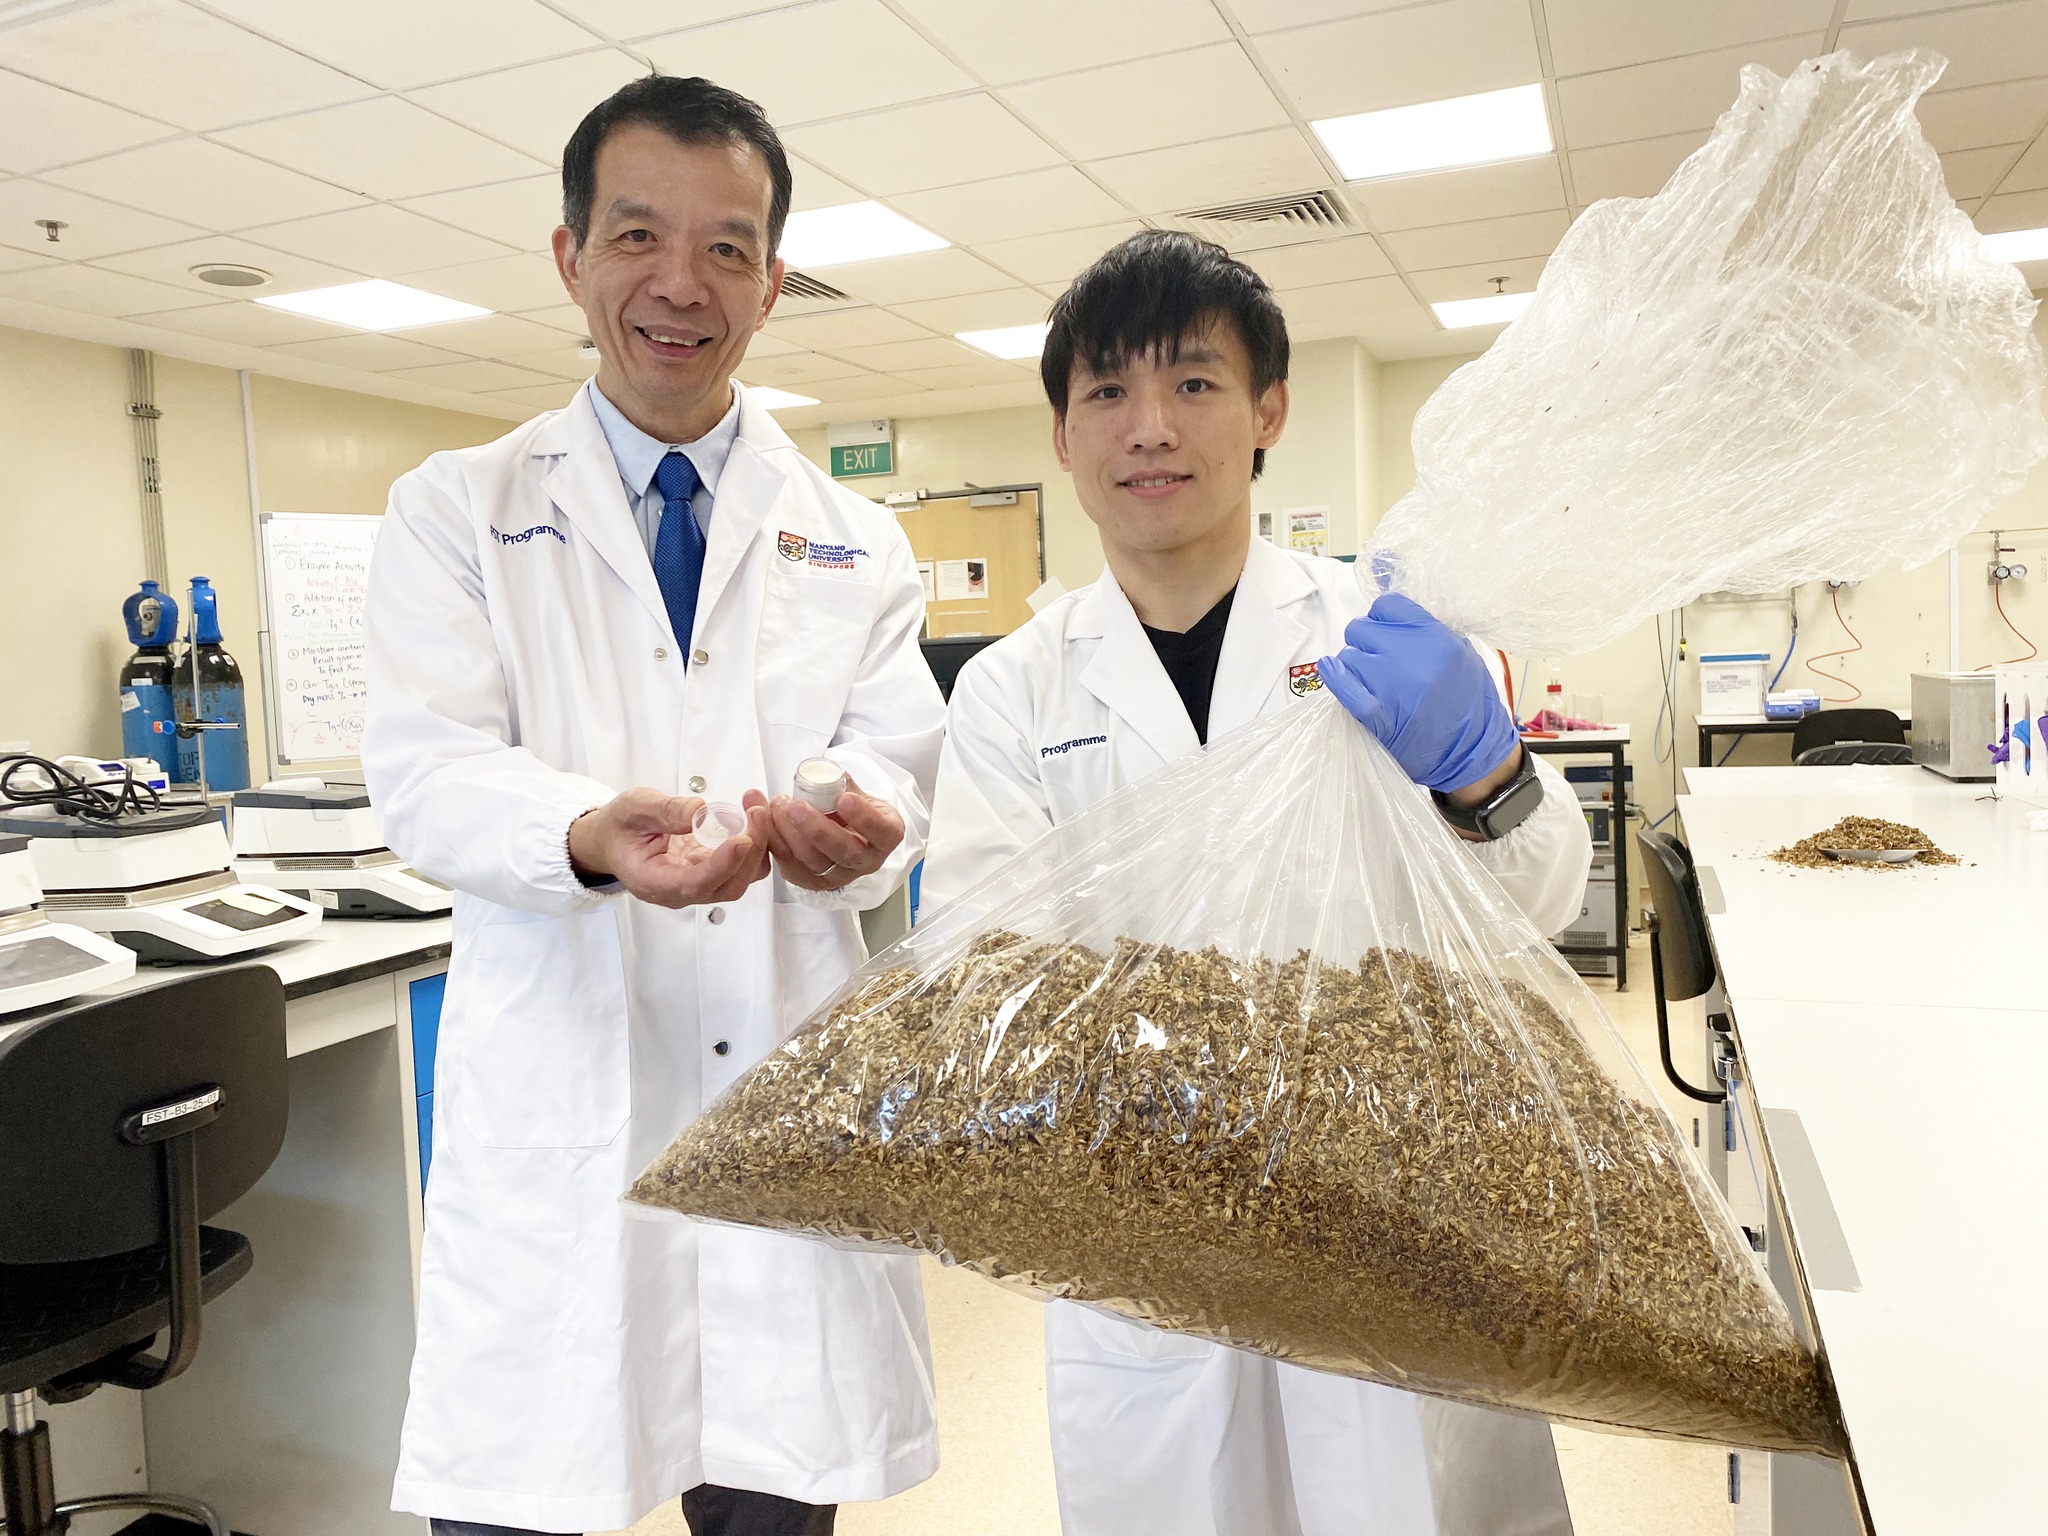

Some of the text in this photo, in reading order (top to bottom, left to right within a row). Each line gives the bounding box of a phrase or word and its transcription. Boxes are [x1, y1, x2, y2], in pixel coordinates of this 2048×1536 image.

[843, 447, 877, 470] EXIT
[502, 525, 566, 545] Programme
[809, 541, 845, 551] NANYANG
[299, 558, 330, 573] Enzyme
[335, 562, 365, 575] Activity
[808, 553, 854, 563] UNIVERSITY
[808, 561, 854, 569] SINGAPORE
[302, 645, 335, 656] Moisture
[1040, 735, 1107, 758] Programme
[145, 1092, 217, 1124] FST-B3-25-03
